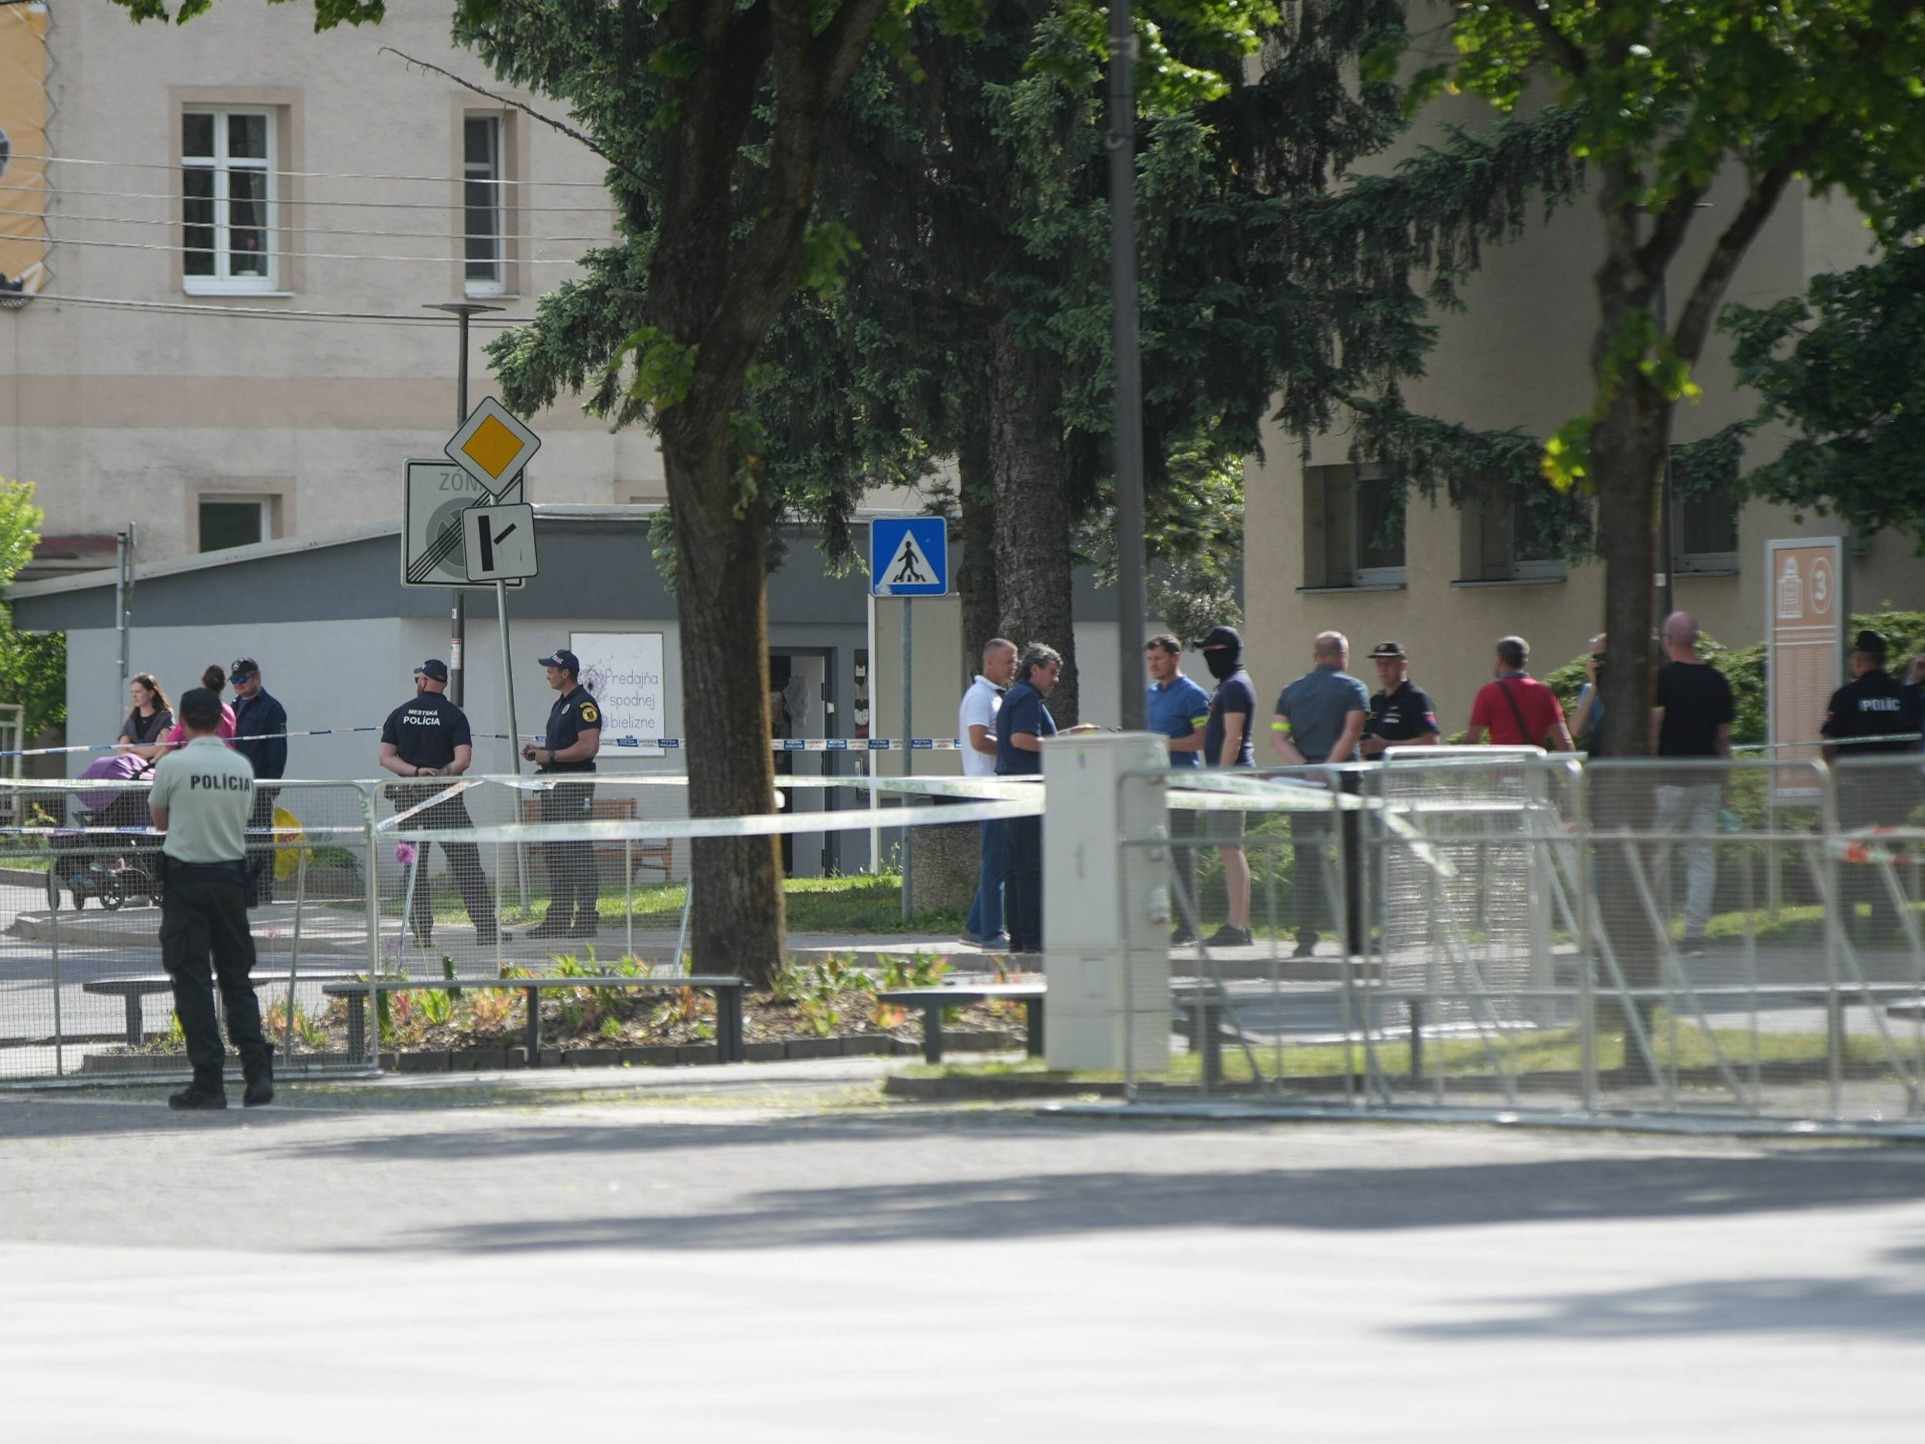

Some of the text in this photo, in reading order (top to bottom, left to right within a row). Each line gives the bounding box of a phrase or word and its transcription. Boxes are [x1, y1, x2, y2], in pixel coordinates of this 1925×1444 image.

[439, 469, 483, 491] ZÓN
[1814, 569, 1827, 600] 3
[605, 669, 659, 689] Predajňa
[610, 690, 655, 710] spodnej
[403, 716, 441, 726] POLÍCIA
[611, 713, 655, 728] bielizne
[190, 773, 250, 793] POLÍCIA
